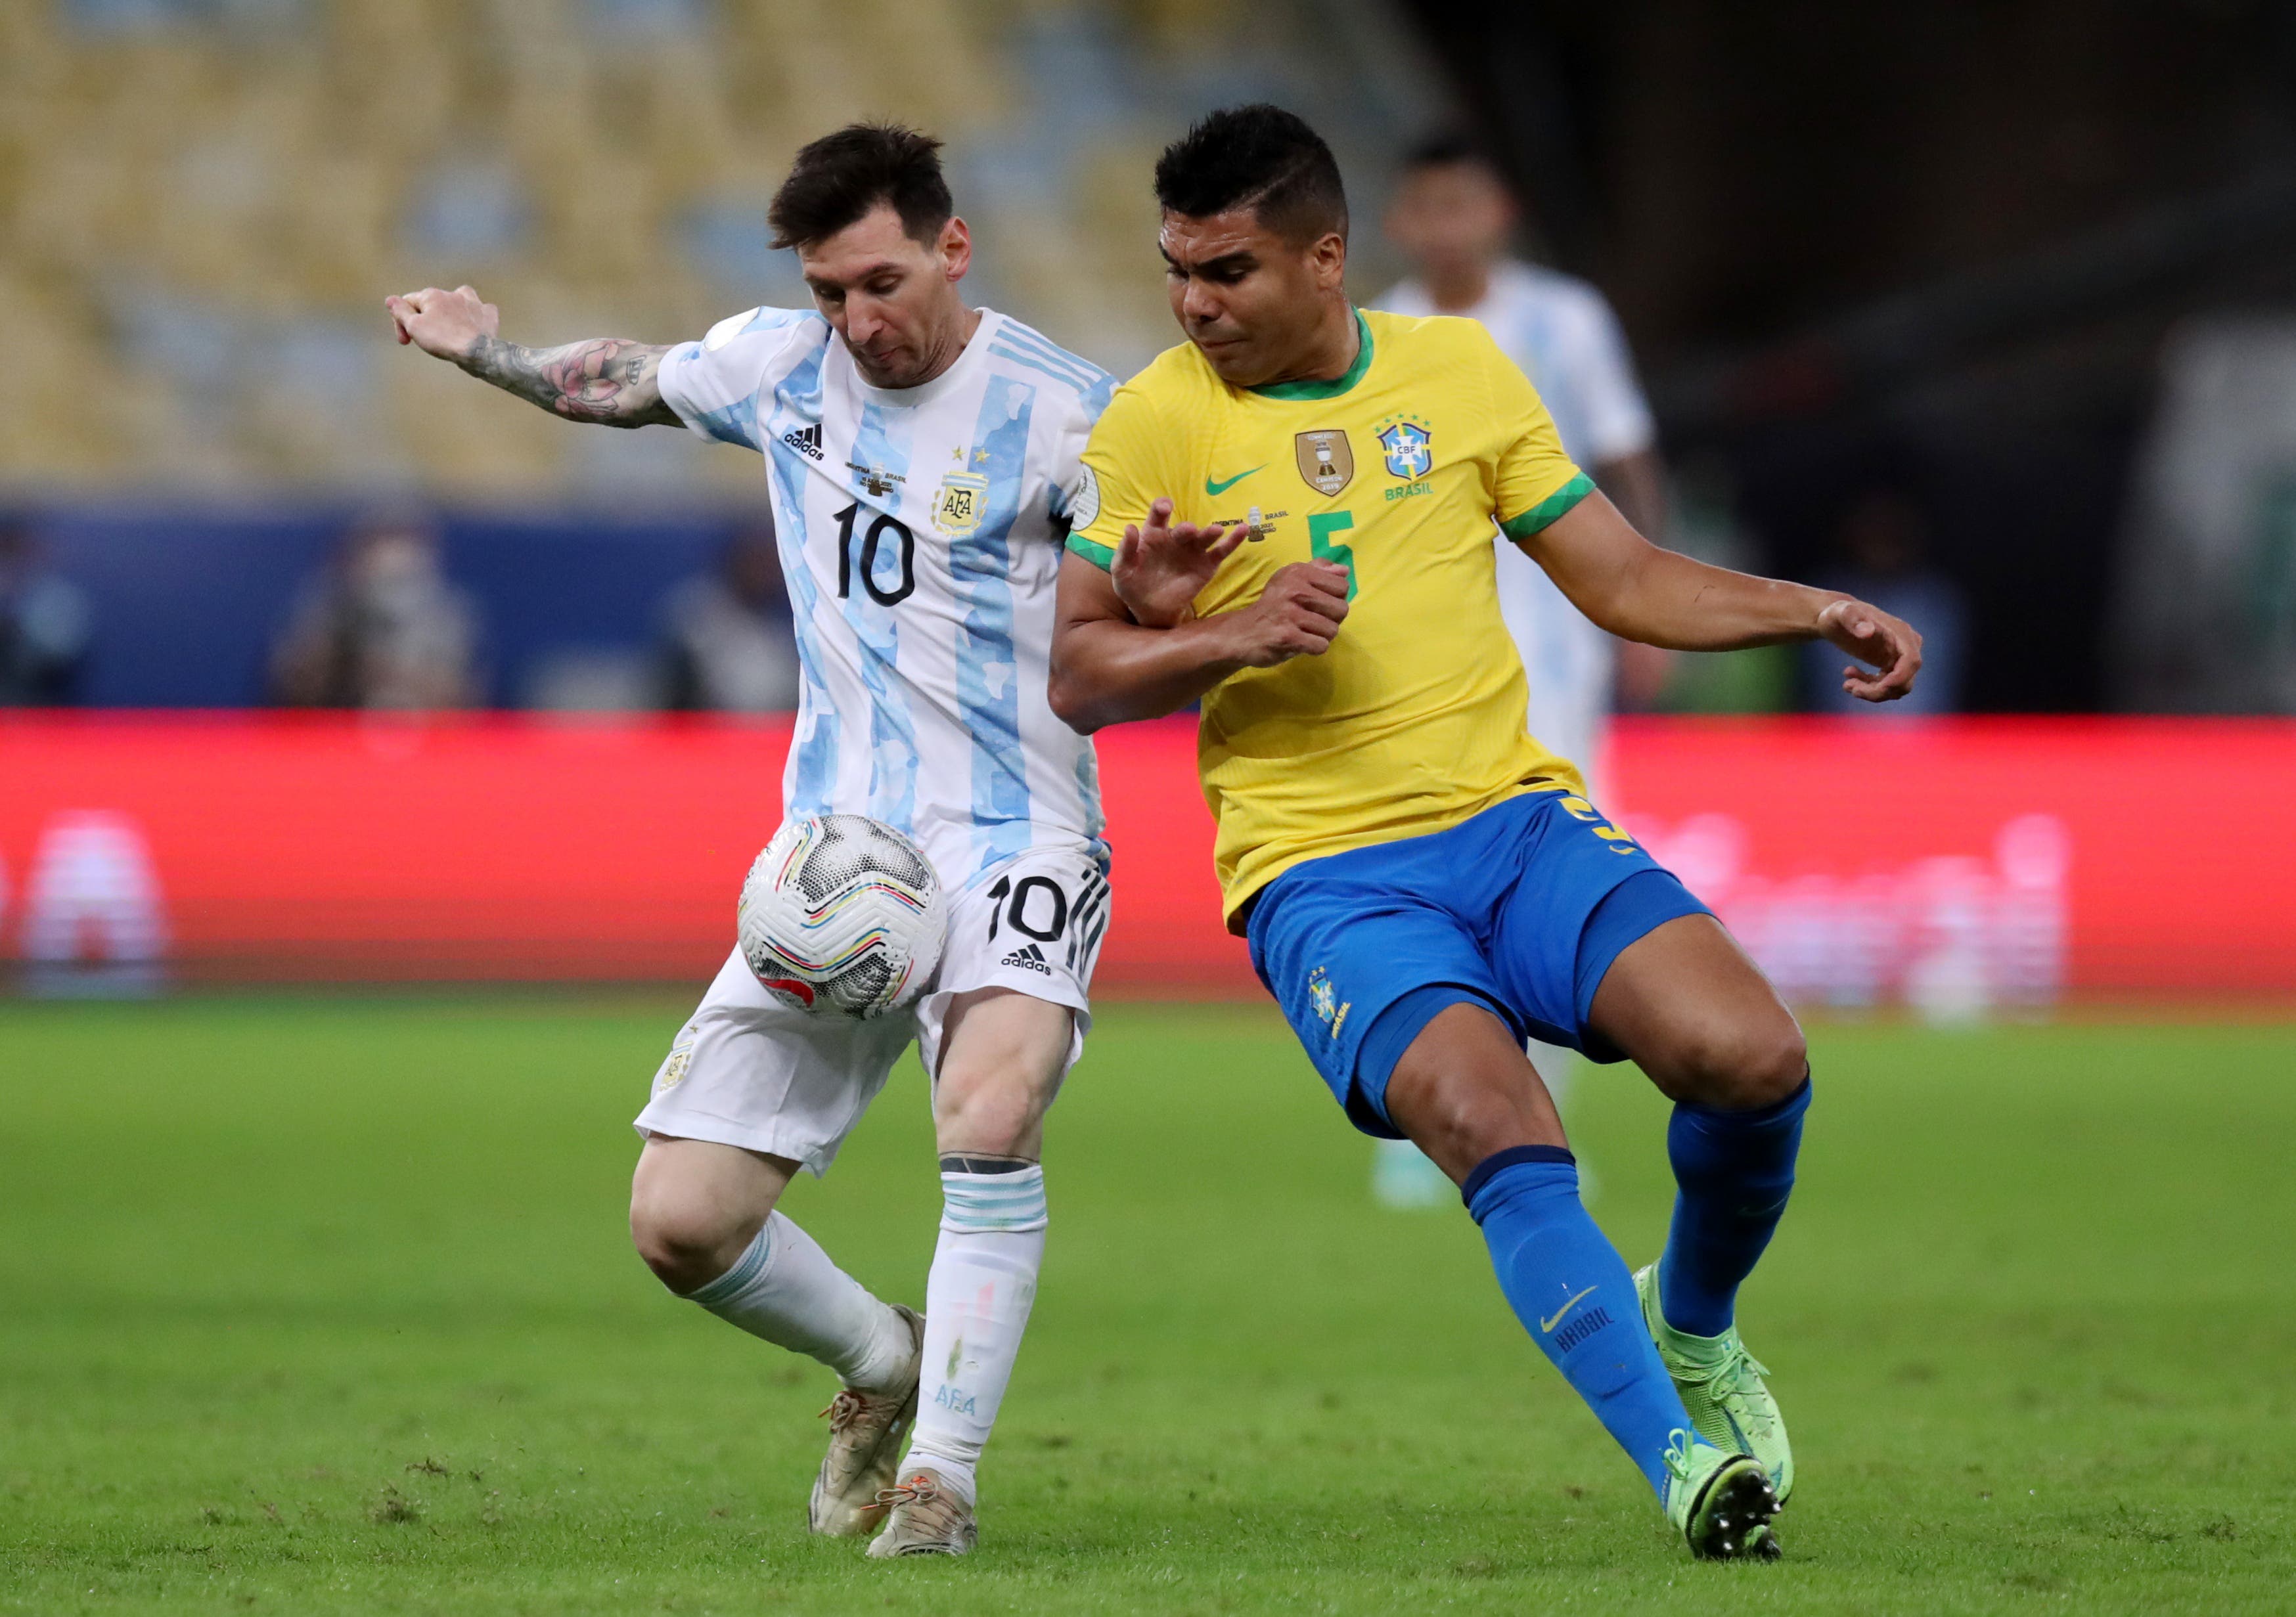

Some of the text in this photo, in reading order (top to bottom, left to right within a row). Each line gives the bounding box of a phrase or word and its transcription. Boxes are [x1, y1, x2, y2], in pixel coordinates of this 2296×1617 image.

[784, 433, 824, 461] adidas
[1397, 446, 1416, 454] CBF
[885, 473, 907, 483] BRASIL
[1385, 483, 1433, 501] BRASIL
[943, 488, 972, 519] AFA
[1265, 510, 1289, 520] BRASIL
[832, 502, 915, 608] 10
[1307, 510, 1359, 603] 5
[987, 875, 1067, 945] 10
[1001, 958, 1052, 976] adidas
[935, 1384, 976, 1417] AFA
